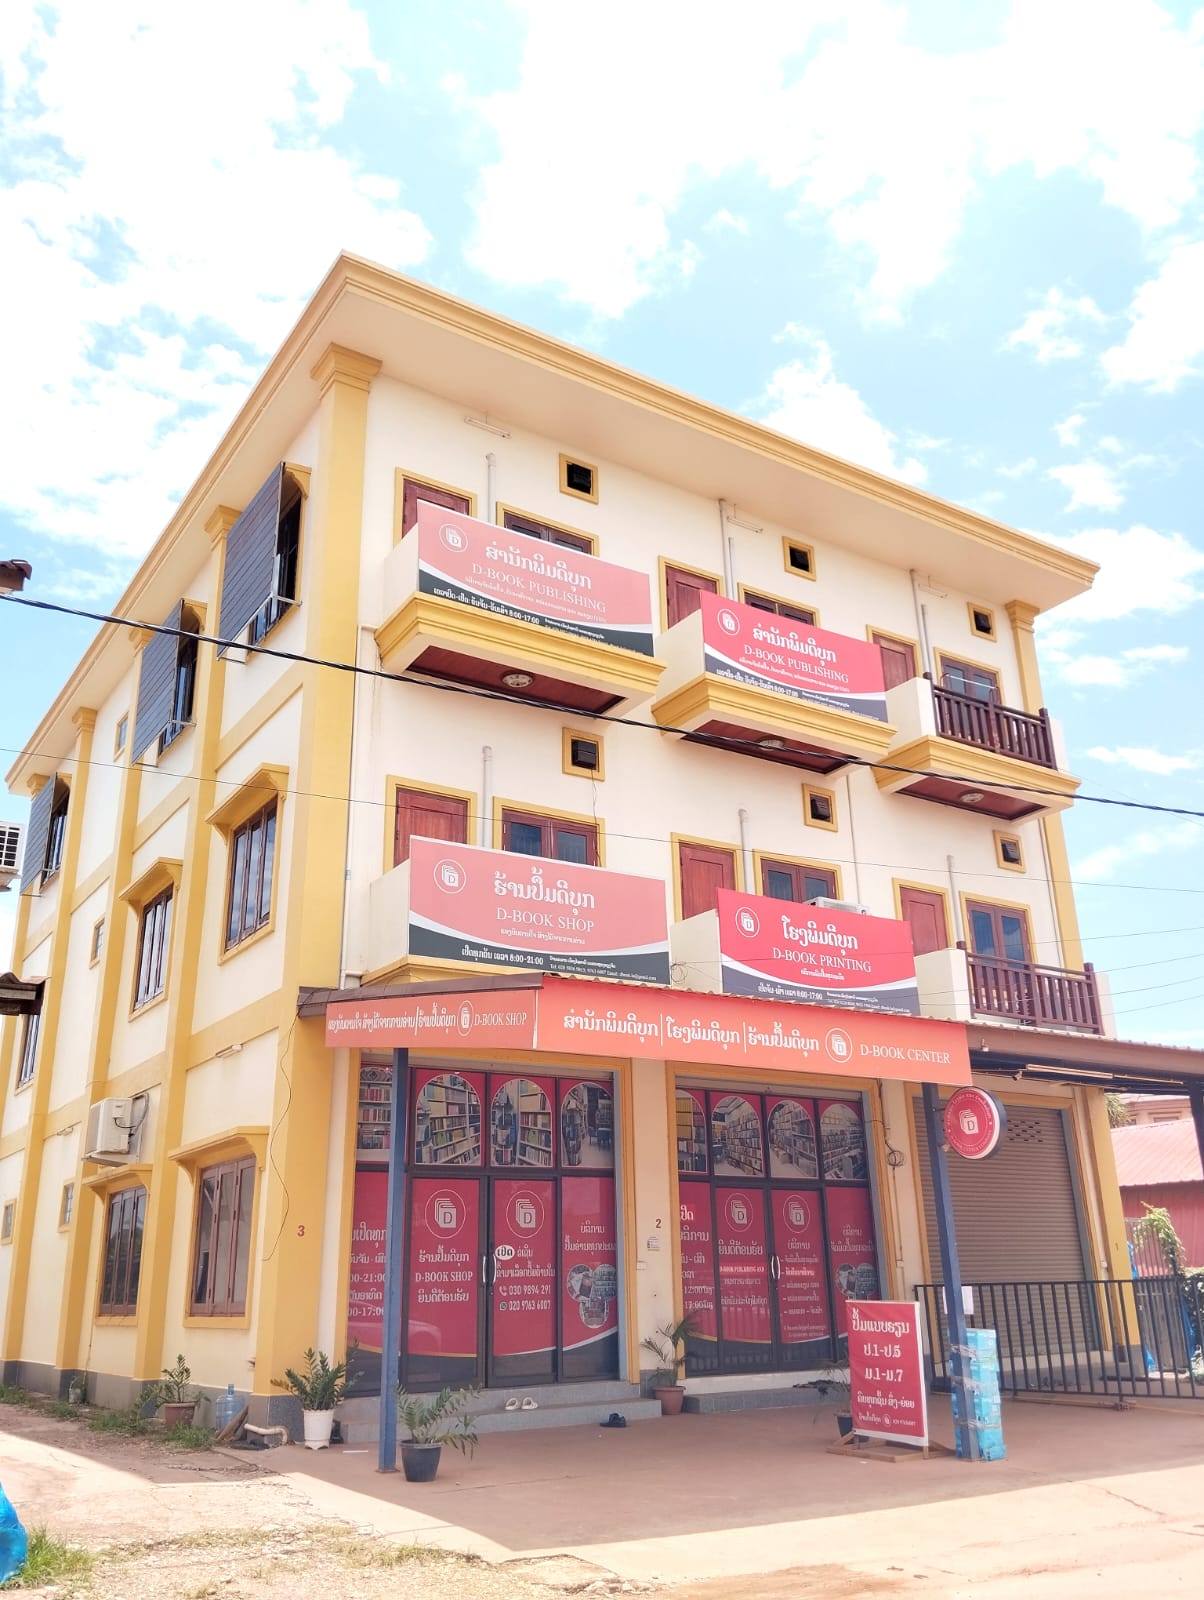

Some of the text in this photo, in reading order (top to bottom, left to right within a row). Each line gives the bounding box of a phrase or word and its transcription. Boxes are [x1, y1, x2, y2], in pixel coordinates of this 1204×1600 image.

[472, 563, 526, 589] D-BOOK
[529, 582, 606, 613] PUBLISHING
[744, 644, 785, 666] D-BOOK
[788, 658, 849, 683] PUBLISHING
[496, 907, 594, 932] D-BOOK SHOP
[510, 953, 544, 966] 8:00-21:00
[773, 947, 872, 973] D-BOOK PRINTING
[473, 1012, 504, 1028] D-BOOK
[505, 1012, 527, 1026] SHOP
[860, 1044, 905, 1060] D-BOOK
[907, 1049, 951, 1064] CENTER
[297, 1224, 305, 1237] 3
[655, 1218, 662, 1229] 2
[415, 1271, 473, 1282] D-BOOK SHOP
[863, 1342, 902, 1358] ປ.1-ປ.5
[864, 1367, 904, 1382] ມ.1-ມ.7
